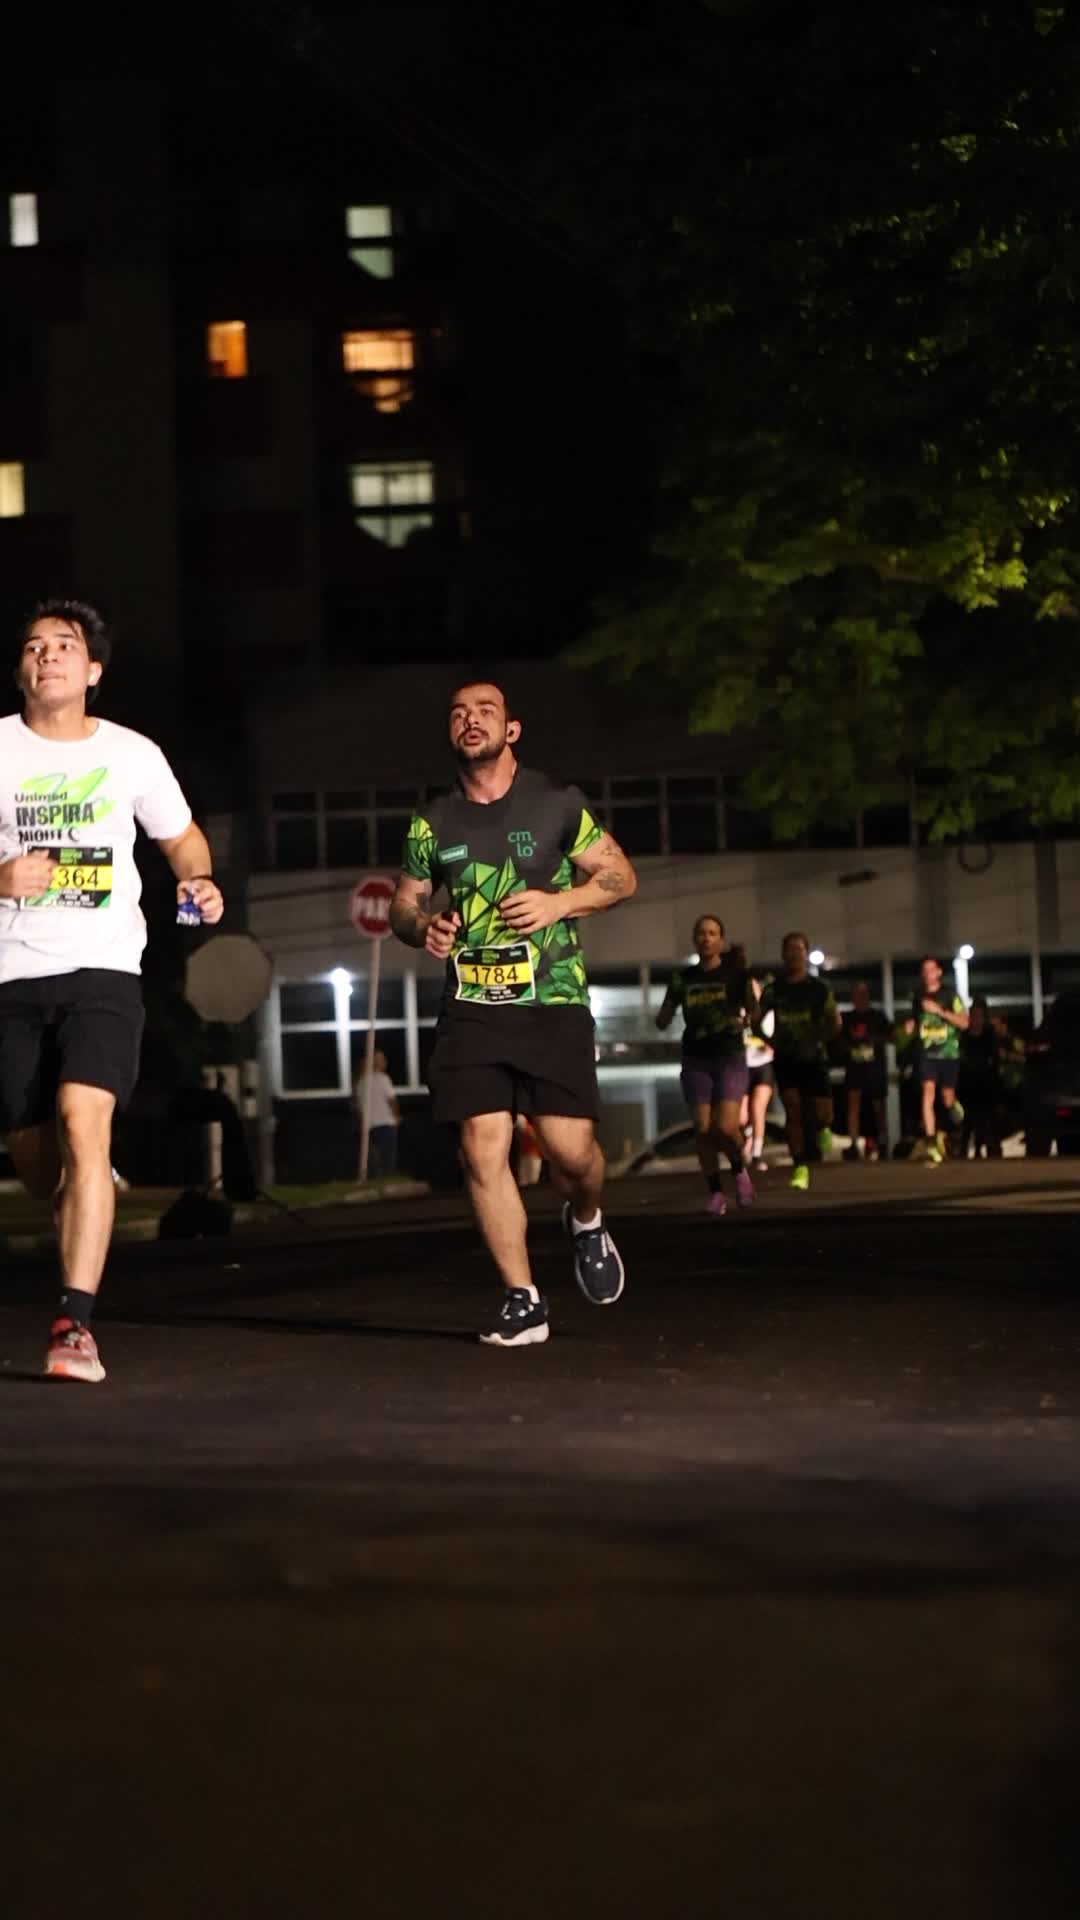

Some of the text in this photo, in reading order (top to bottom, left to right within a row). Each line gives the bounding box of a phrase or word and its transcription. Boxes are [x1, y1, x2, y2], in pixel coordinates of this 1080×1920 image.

[14, 791, 68, 803] Unimed
[15, 803, 95, 827] INSPIRA
[57, 867, 99, 888] 364
[471, 965, 519, 985] 1784
